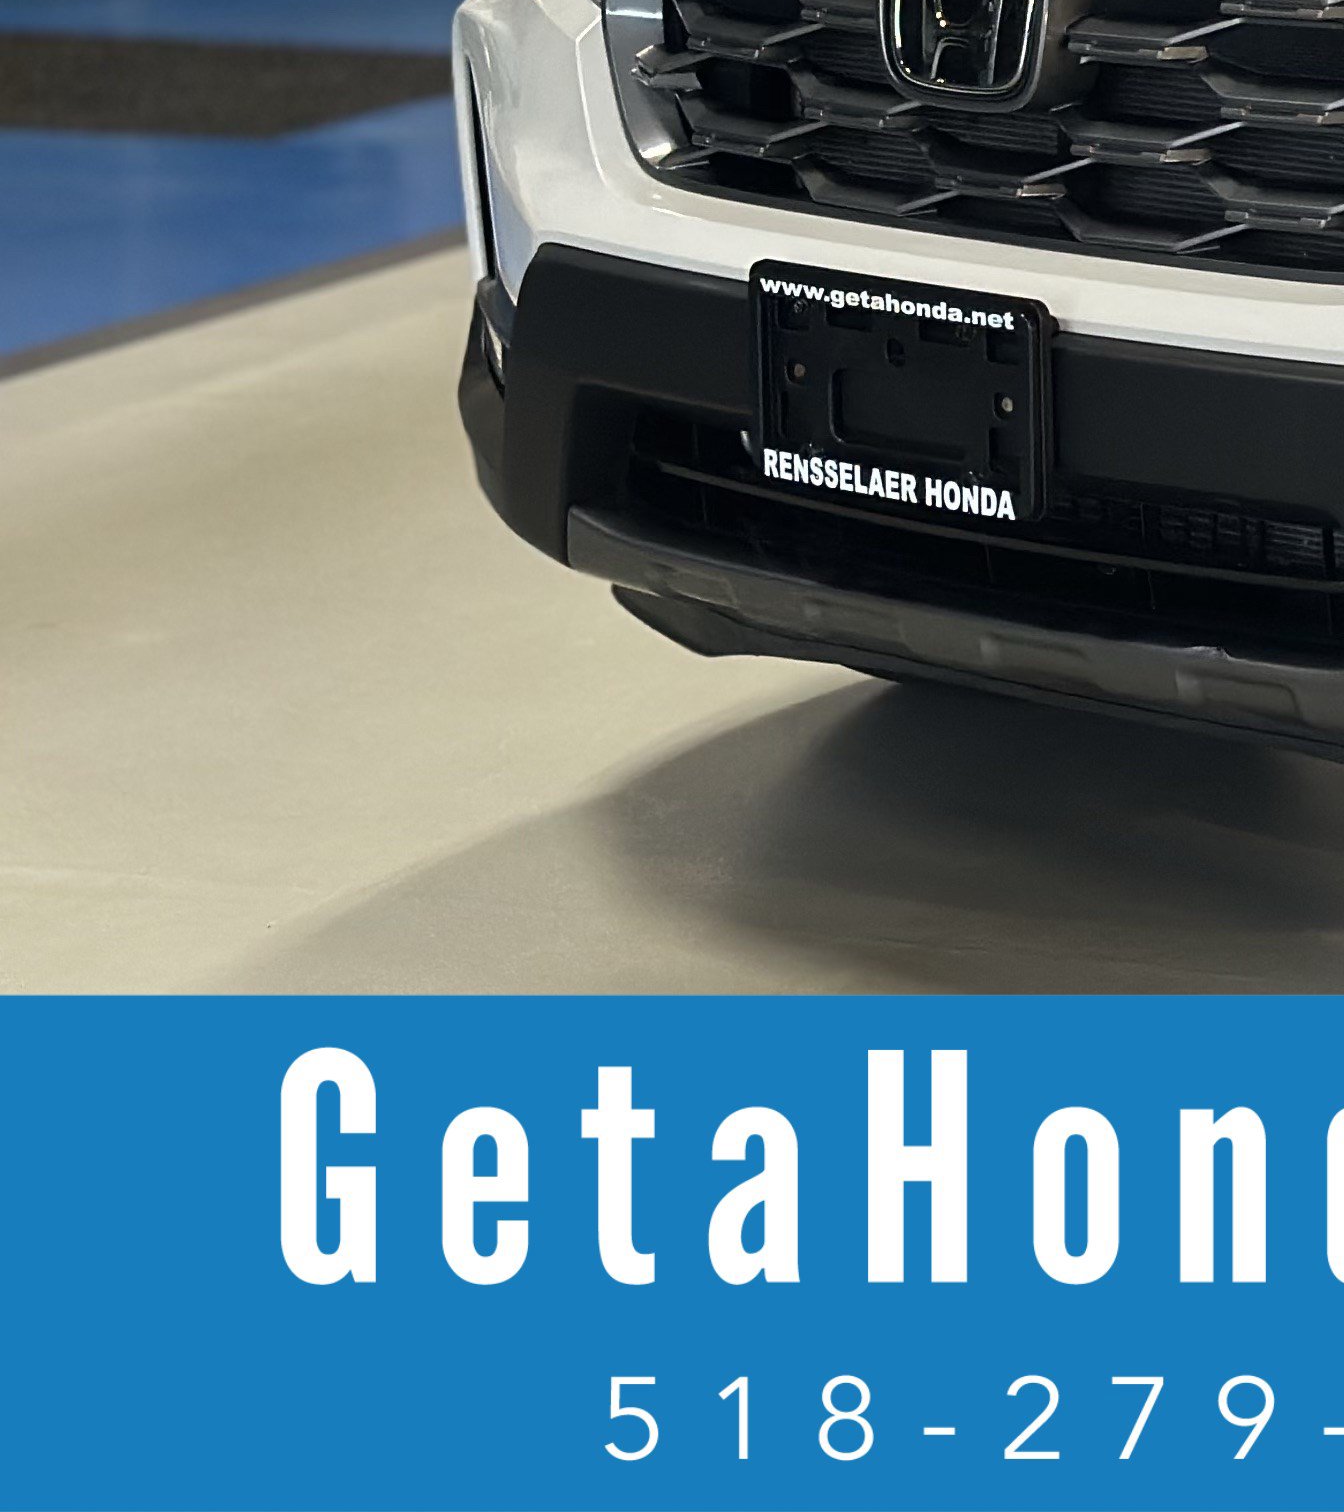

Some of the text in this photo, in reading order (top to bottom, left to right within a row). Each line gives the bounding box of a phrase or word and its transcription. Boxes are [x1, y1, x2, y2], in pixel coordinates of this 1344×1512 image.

[760, 277, 1014, 330] www.getahonda.net
[763, 448, 1016, 521] RENSSELAER HONDA
